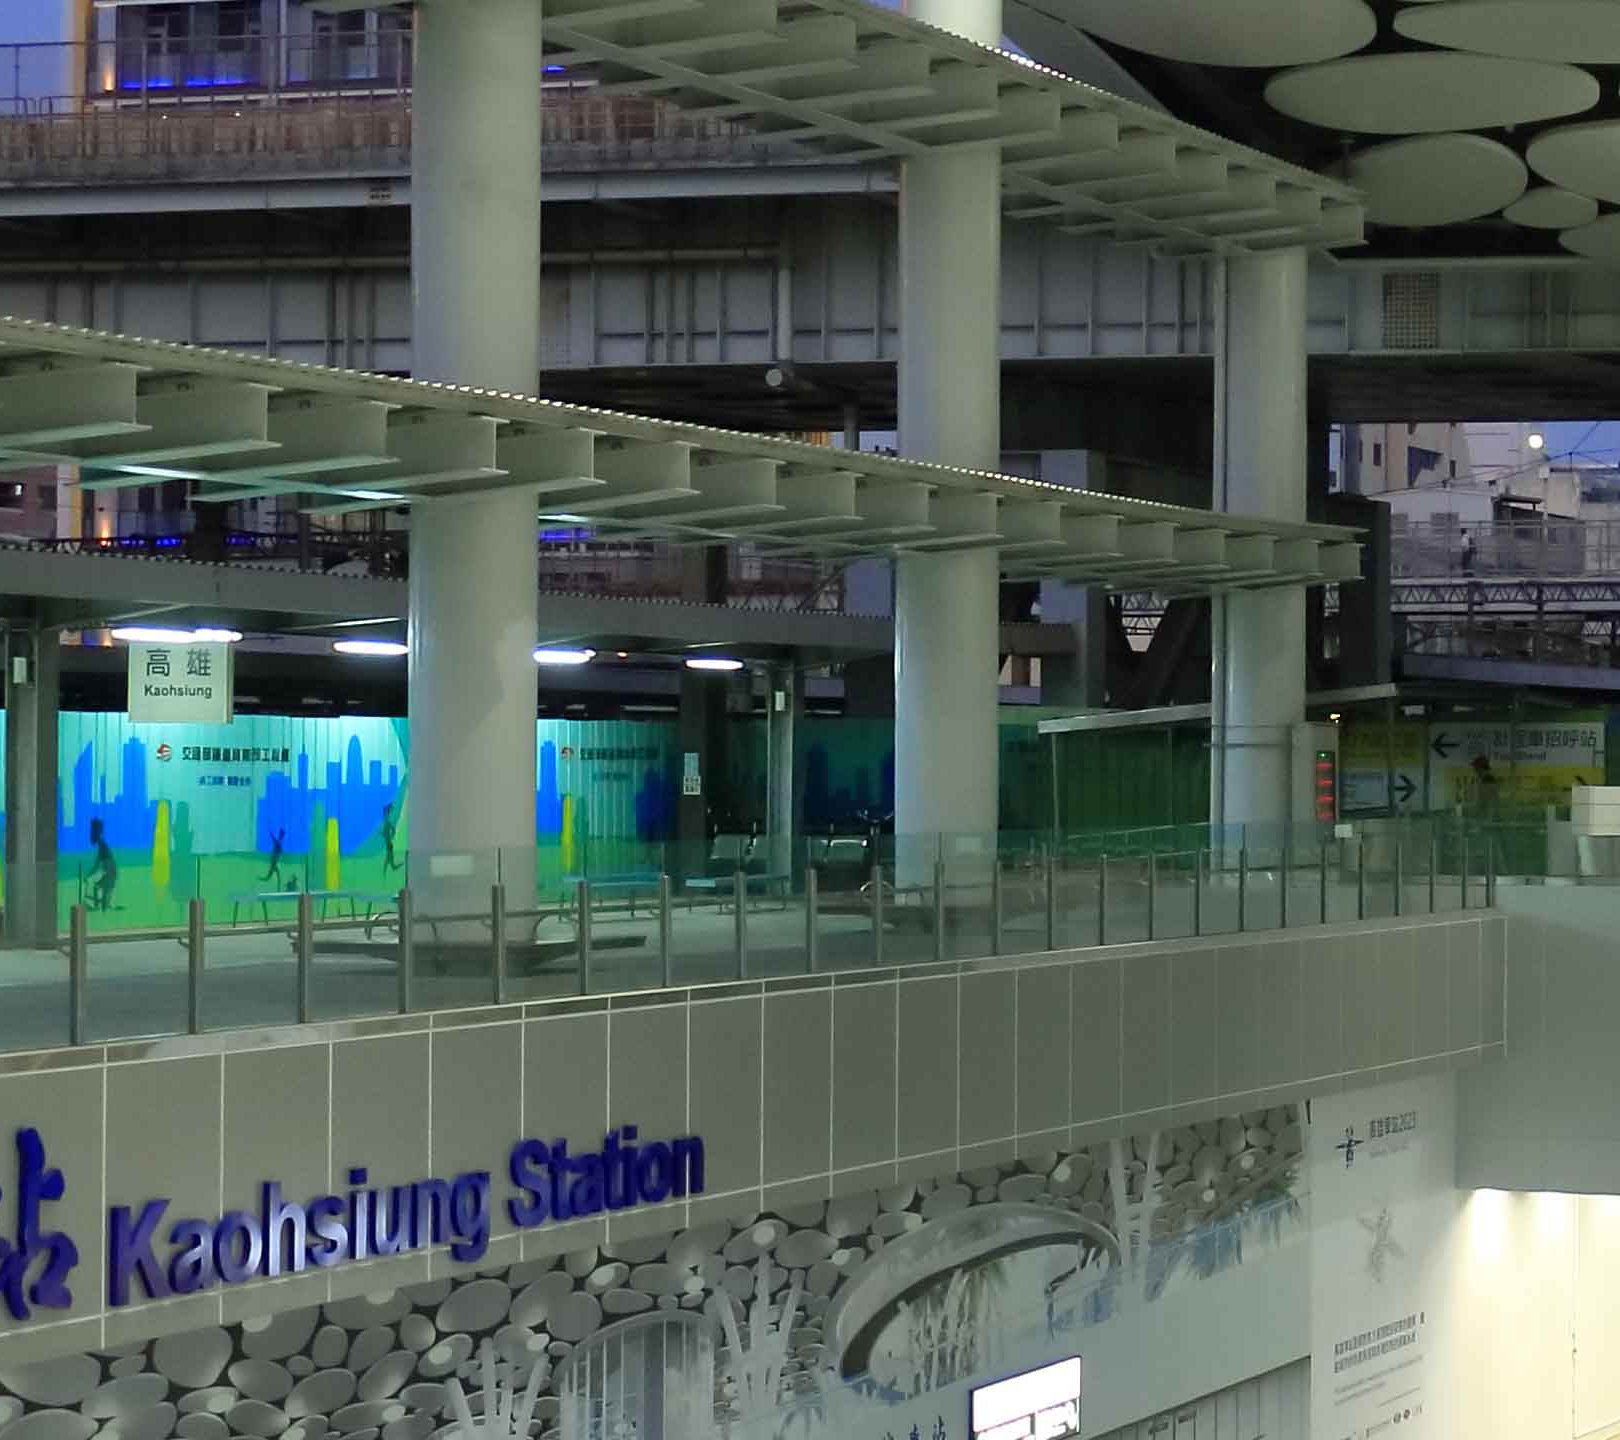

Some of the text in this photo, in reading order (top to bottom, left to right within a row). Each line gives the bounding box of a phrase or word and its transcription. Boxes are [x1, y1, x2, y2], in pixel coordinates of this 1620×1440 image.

[146, 648, 211, 677] 高雄
[144, 684, 212, 699] Kaohsiung
[108, 1125, 705, 1307] Kaohsiung Station
